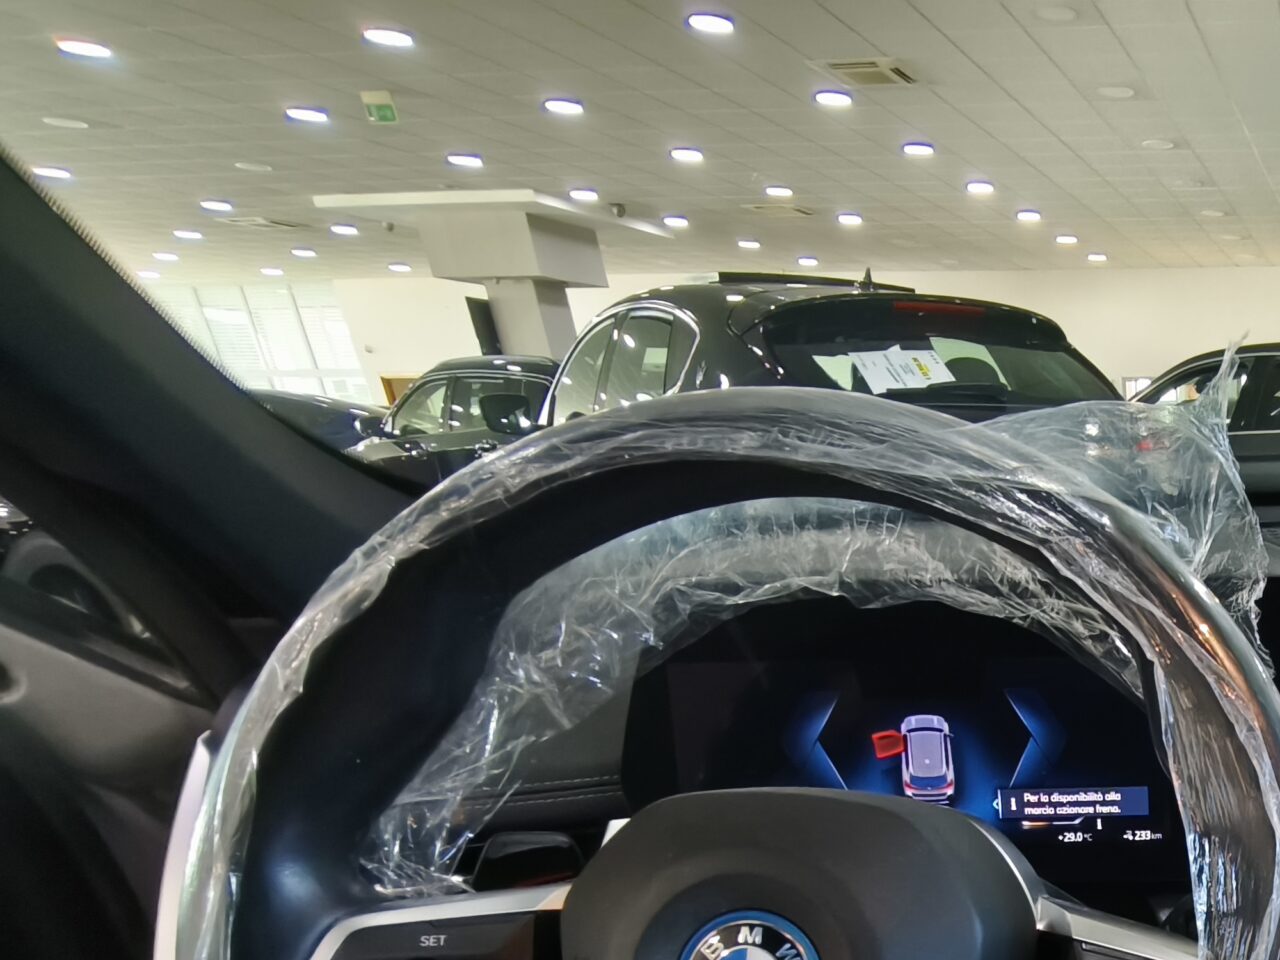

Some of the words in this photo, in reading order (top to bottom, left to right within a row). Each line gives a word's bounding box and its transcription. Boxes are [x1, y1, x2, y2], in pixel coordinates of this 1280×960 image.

[1023, 792, 1039, 802] Per
[1134, 831, 1151, 840] 233
[419, 935, 447, 947] SET
